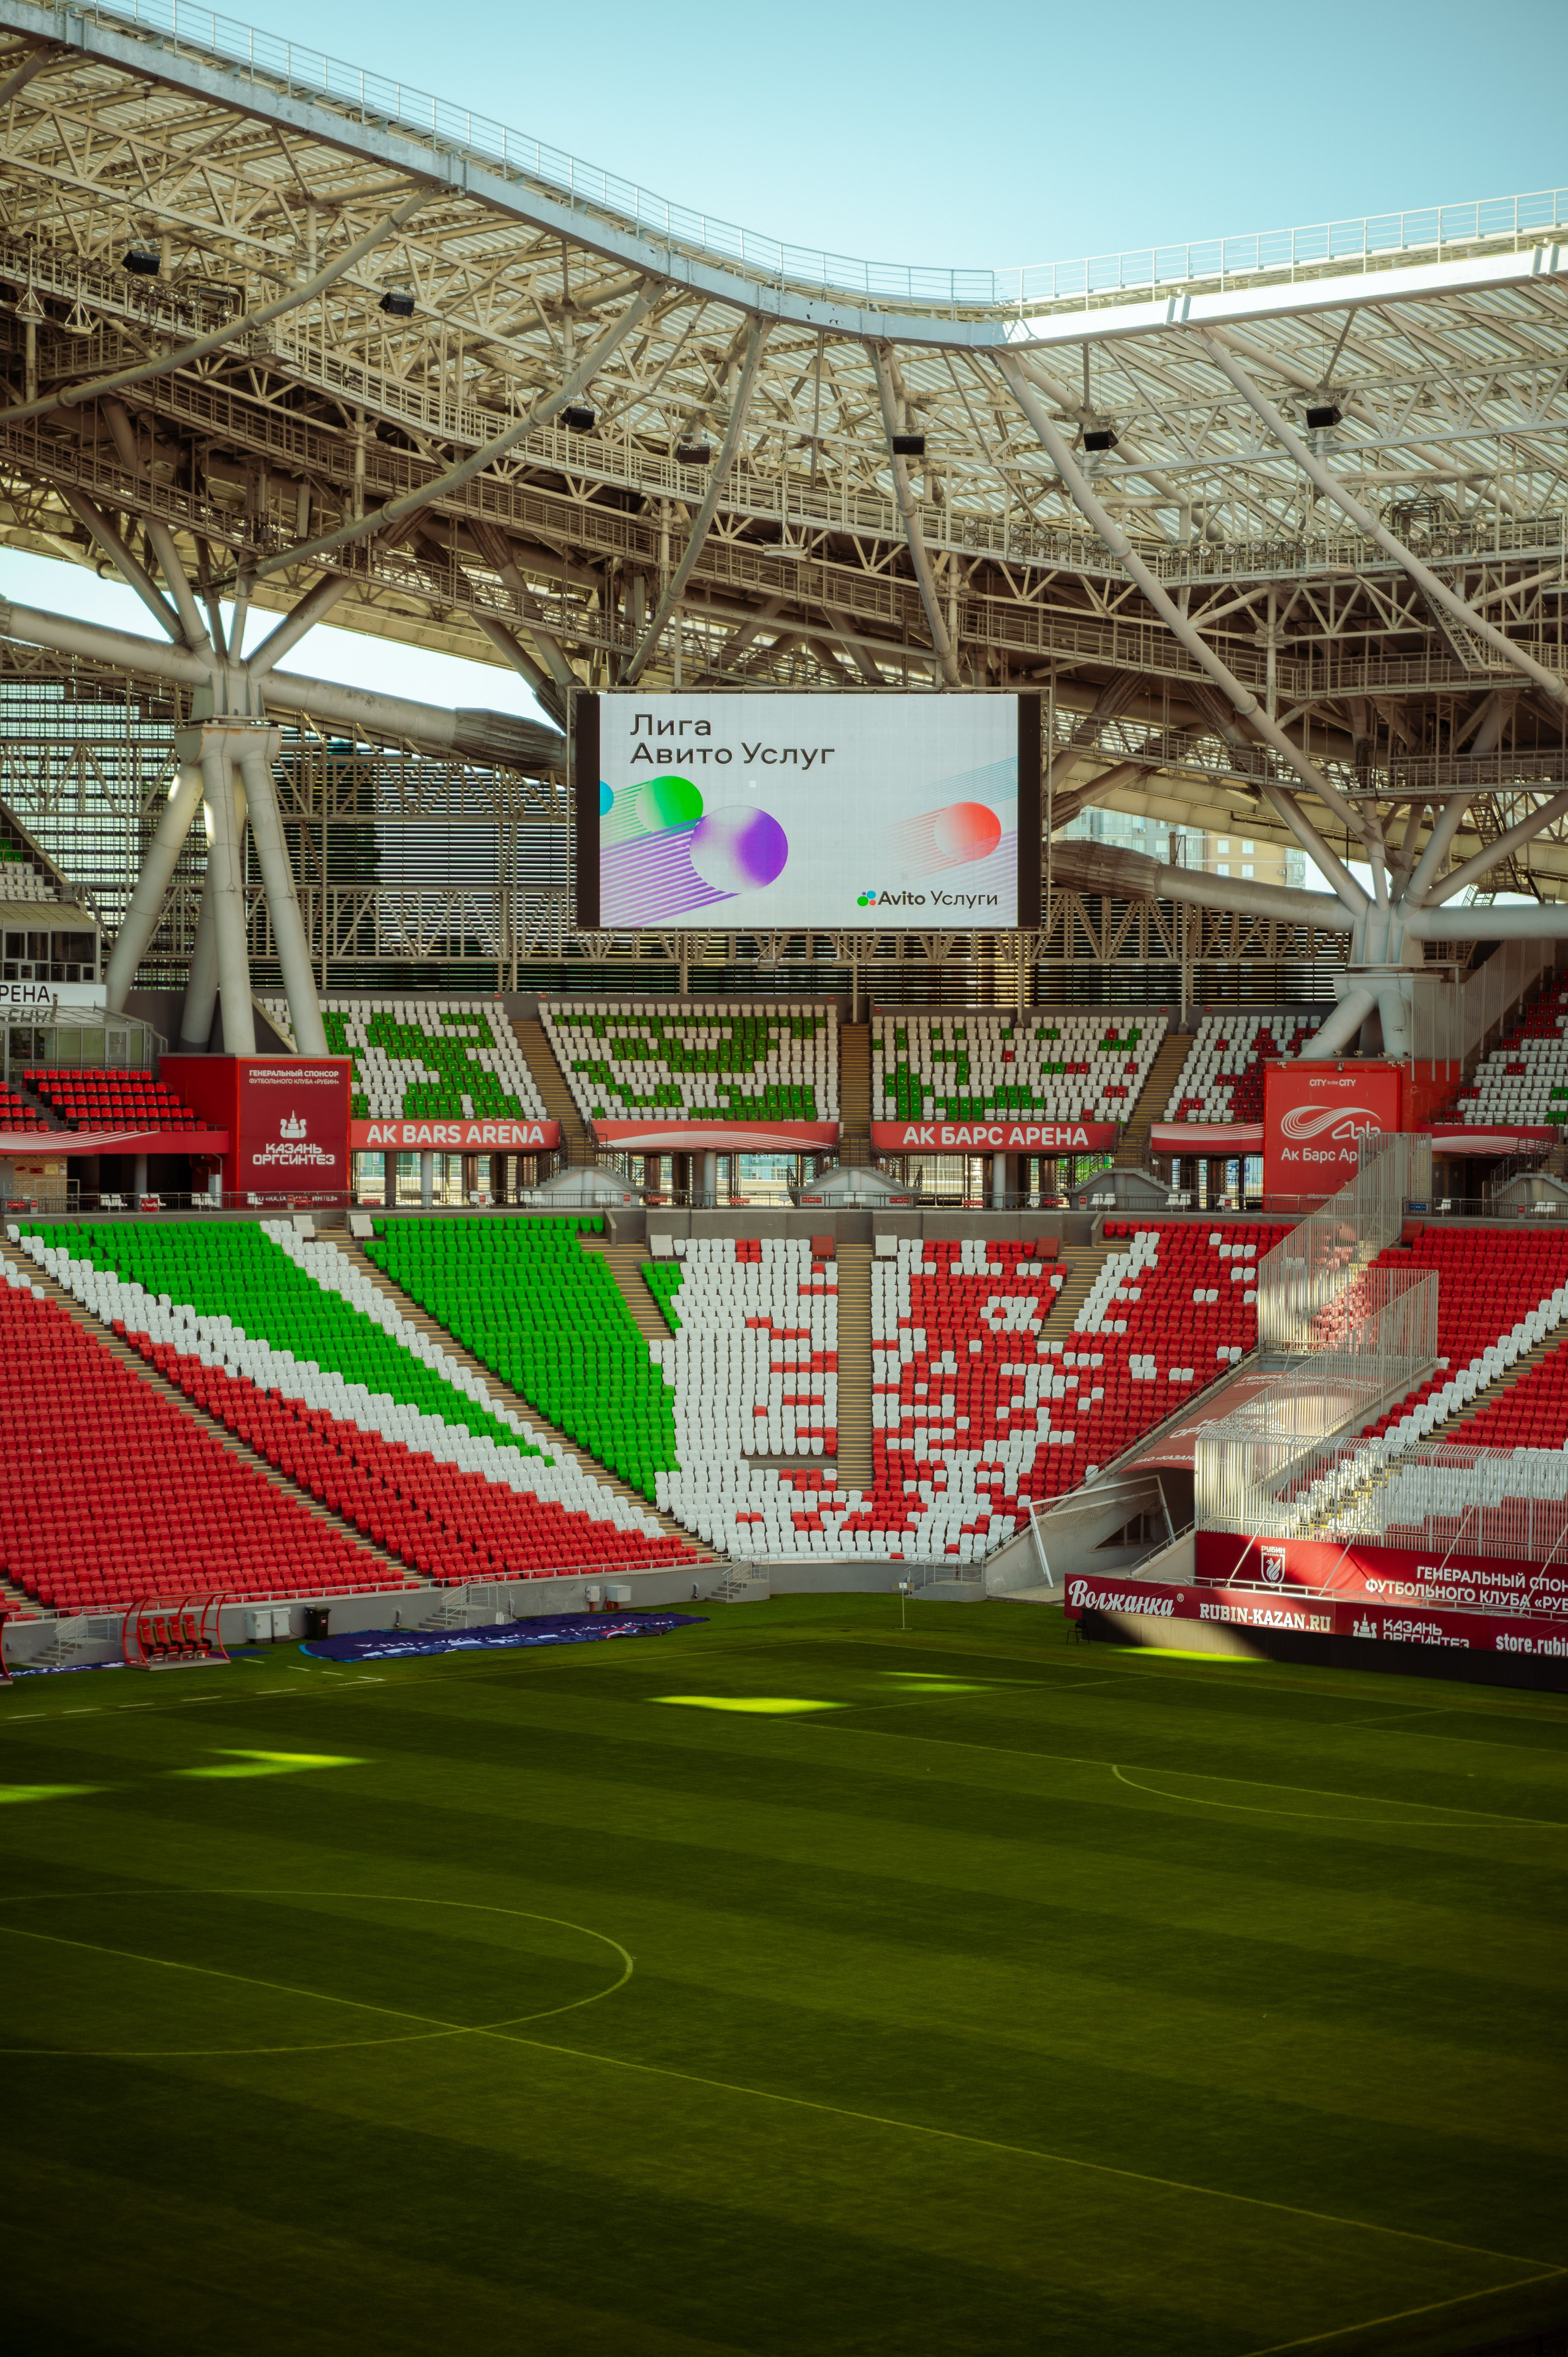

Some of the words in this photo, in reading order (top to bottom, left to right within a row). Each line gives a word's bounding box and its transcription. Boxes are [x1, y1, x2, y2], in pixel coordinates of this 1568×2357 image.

[630, 714, 712, 736] Лига
[630, 743, 733, 765] Авито
[741, 742, 835, 770] Услуг
[878, 889, 926, 906] Avito
[930, 891, 998, 908] Услуги
[366, 1125, 396, 1144] AK
[402, 1125, 461, 1144] BARS
[466, 1125, 544, 1144] ARENA
[903, 1127, 935, 1145] АК
[940, 1127, 1003, 1145] БАРС
[1008, 1127, 1088, 1145] АРЕНА
[266, 1144, 322, 1153] КАЗАНЬ
[1281, 1147, 1299, 1161] Ак
[1303, 1148, 1336, 1164] Барс
[252, 1155, 335, 1165] ОРГСИНТЕЗ
[1261, 1545, 1286, 1554] РУБИН
[1417, 1566, 1526, 1588] ГЕНЕРАЛЬНЫЙ
[1068, 1580, 1174, 1616] Волжанка
[1365, 1577, 1476, 1602] ФУТБОЛЬНОГО
[1480, 1590, 1531, 1607] КЛУБА
[1199, 1603, 1331, 1632] RUBIN-KAZAN.RU
[1383, 1619, 1442, 1636] КАЗАНЬ
